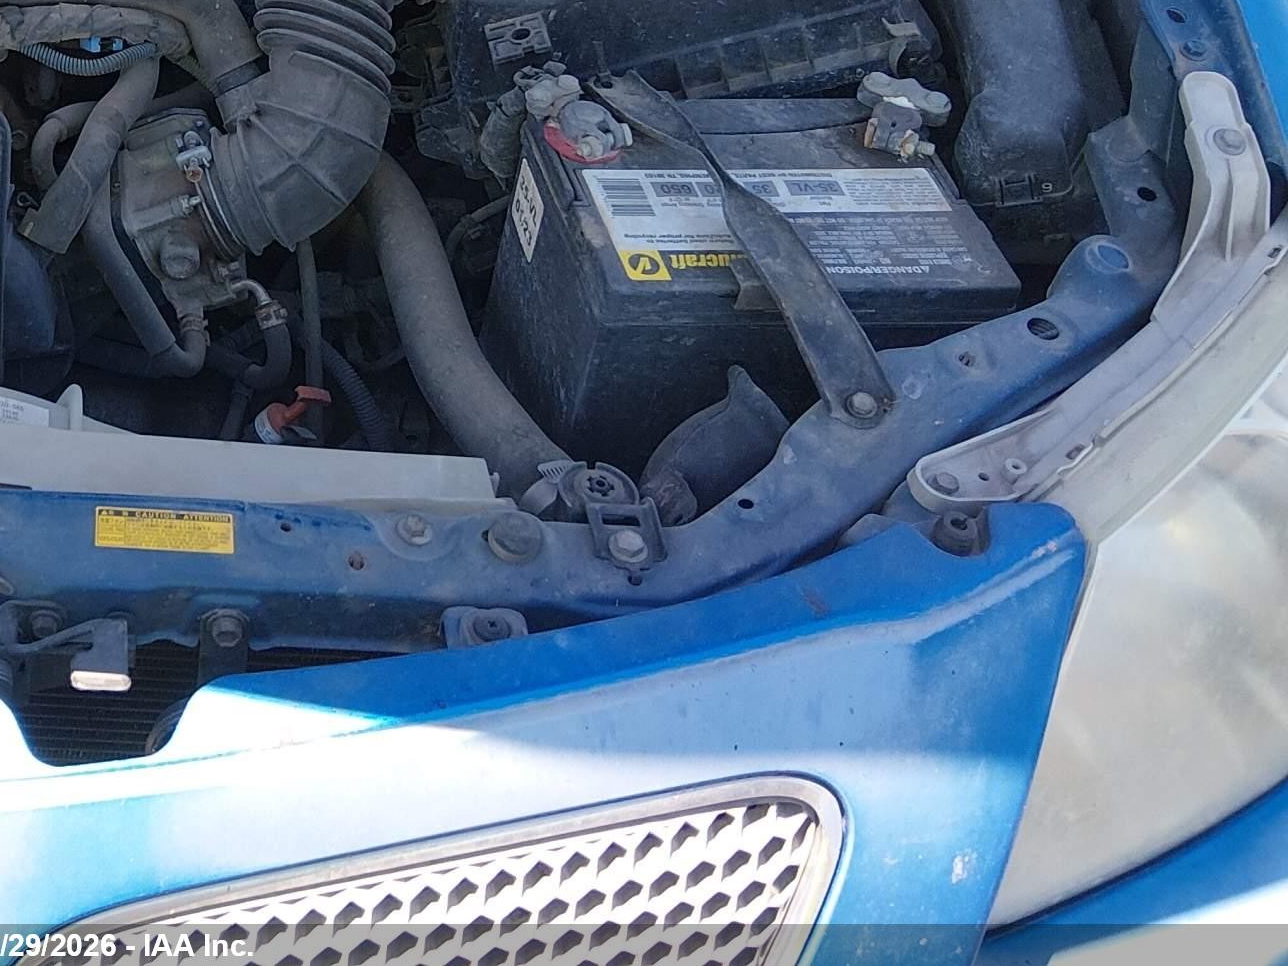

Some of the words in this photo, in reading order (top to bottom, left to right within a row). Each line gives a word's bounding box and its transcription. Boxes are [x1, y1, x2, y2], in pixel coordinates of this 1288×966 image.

[658, 184, 693, 194] 650
[750, 184, 773, 193] 35
[791, 182, 839, 192] 35-VL
[670, 253, 750, 269] ucraft
